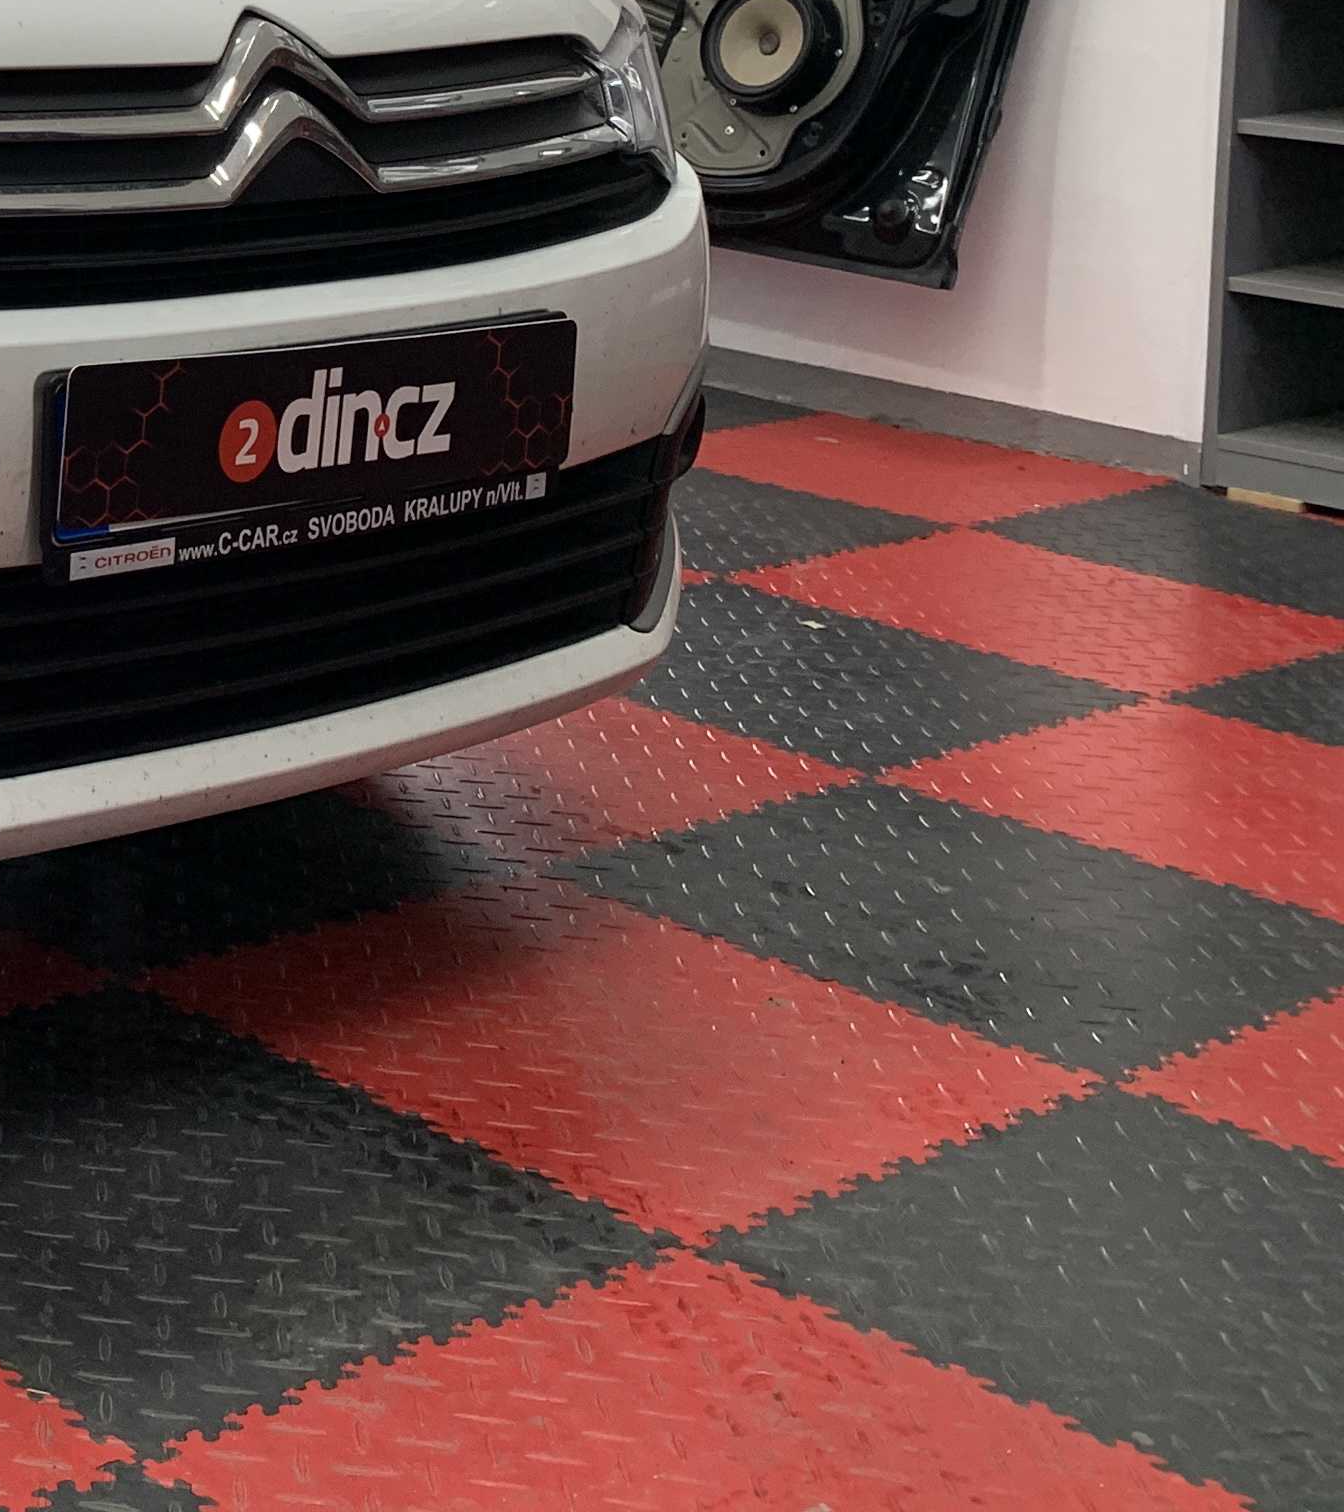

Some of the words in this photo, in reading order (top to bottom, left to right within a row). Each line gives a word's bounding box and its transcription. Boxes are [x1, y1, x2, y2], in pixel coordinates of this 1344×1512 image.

[178, 523, 299, 562] www.C-CAR.cz
[307, 503, 396, 541] SVOBODA
[404, 487, 484, 523] KRALUPY
